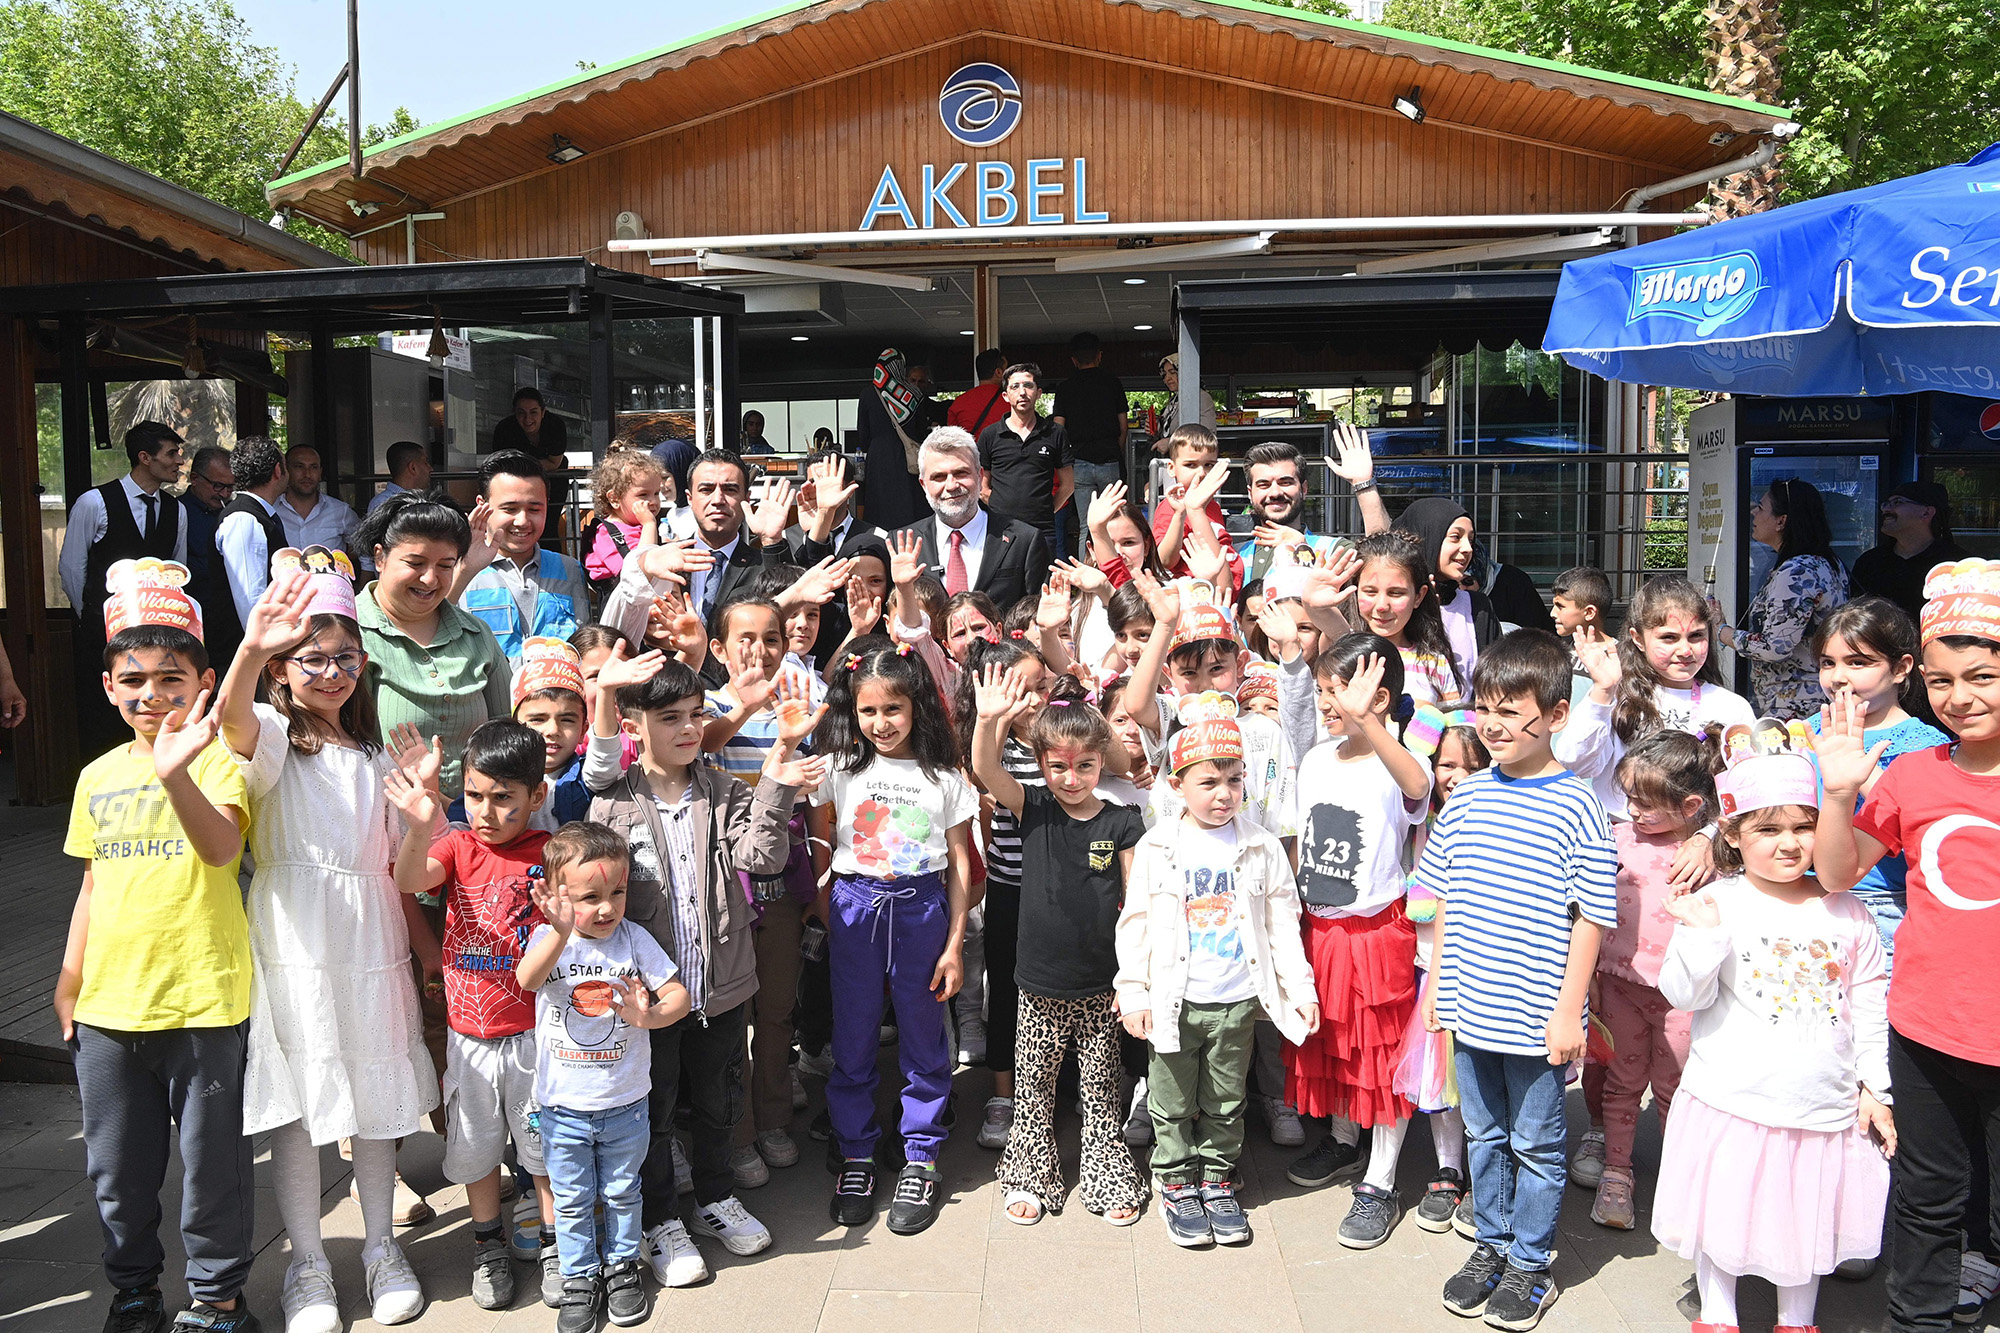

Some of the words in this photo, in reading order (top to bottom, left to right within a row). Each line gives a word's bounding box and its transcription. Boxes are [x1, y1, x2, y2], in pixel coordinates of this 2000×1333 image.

[858, 157, 1109, 230] AKBEL
[1640, 265, 1746, 307] Mardo
[397, 339, 426, 350] Kafem
[1778, 404, 1862, 422] MARSU
[1697, 428, 1726, 451] MARSU
[138, 591, 191, 614] Nisan
[1940, 596, 2000, 624] Nisa
[145, 611, 191, 627] OLSUN
[1177, 611, 1221, 631] Nisan
[1955, 619, 2000, 638] OLSU
[524, 662, 546, 682] 23
[1181, 726, 1201, 749] 23
[1202, 723, 1241, 743] Nisan
[1181, 743, 1215, 761] KUTLU
[866, 781, 890, 791] Let's
[893, 783, 922, 794] Grow
[870, 793, 918, 807] Together
[1320, 837, 1351, 864] 23
[455, 954, 513, 971] LTIMATE
[569, 963, 603, 977] STAR
[551, 1010, 561, 1023] 19
[558, 1049, 620, 1061] BASKETBALL
[120, 1300, 144, 1311] Columbia
[182, 1314, 206, 1325] Columbia
